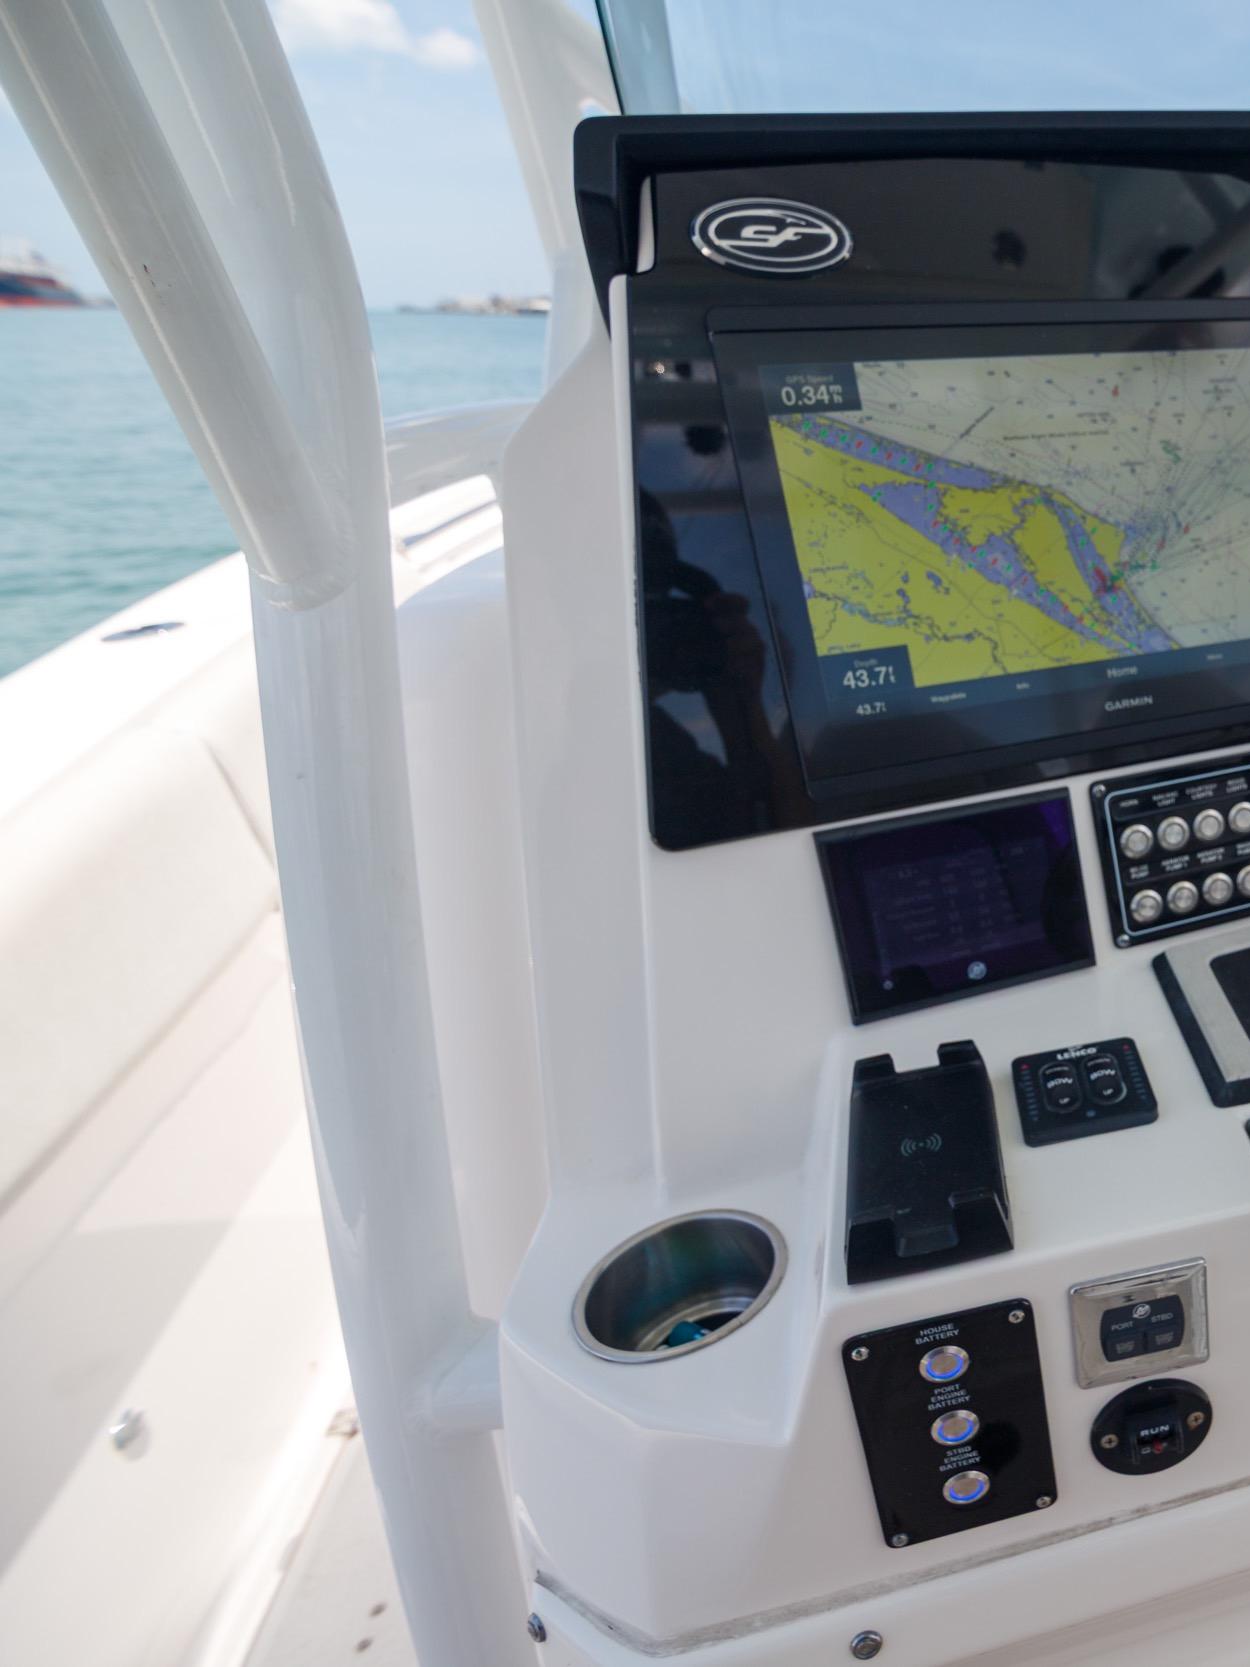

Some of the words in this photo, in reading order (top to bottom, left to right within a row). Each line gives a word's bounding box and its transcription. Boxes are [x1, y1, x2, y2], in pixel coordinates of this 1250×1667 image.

[781, 384, 829, 406] 0.34
[843, 666, 887, 689] 43.7
[1106, 665, 1138, 679] Home
[1104, 695, 1153, 712] GARMIN
[1056, 1047, 1097, 1060] LENCO
[1089, 1069, 1116, 1080] BOW
[1046, 1077, 1073, 1089] BOW
[1151, 1312, 1174, 1323] STBD
[920, 1323, 954, 1336] HOUSE
[1111, 1321, 1134, 1332] PORT
[915, 1329, 960, 1345] BATTERY
[930, 1388, 967, 1403] ENGINE
[934, 1383, 961, 1395] PORT
[927, 1395, 971, 1411] BATTERY
[1140, 1424, 1170, 1437] RUN
[943, 1450, 979, 1464] ENGINE
[946, 1446, 972, 1457] STBD
[939, 1456, 982, 1472] BATTERY
